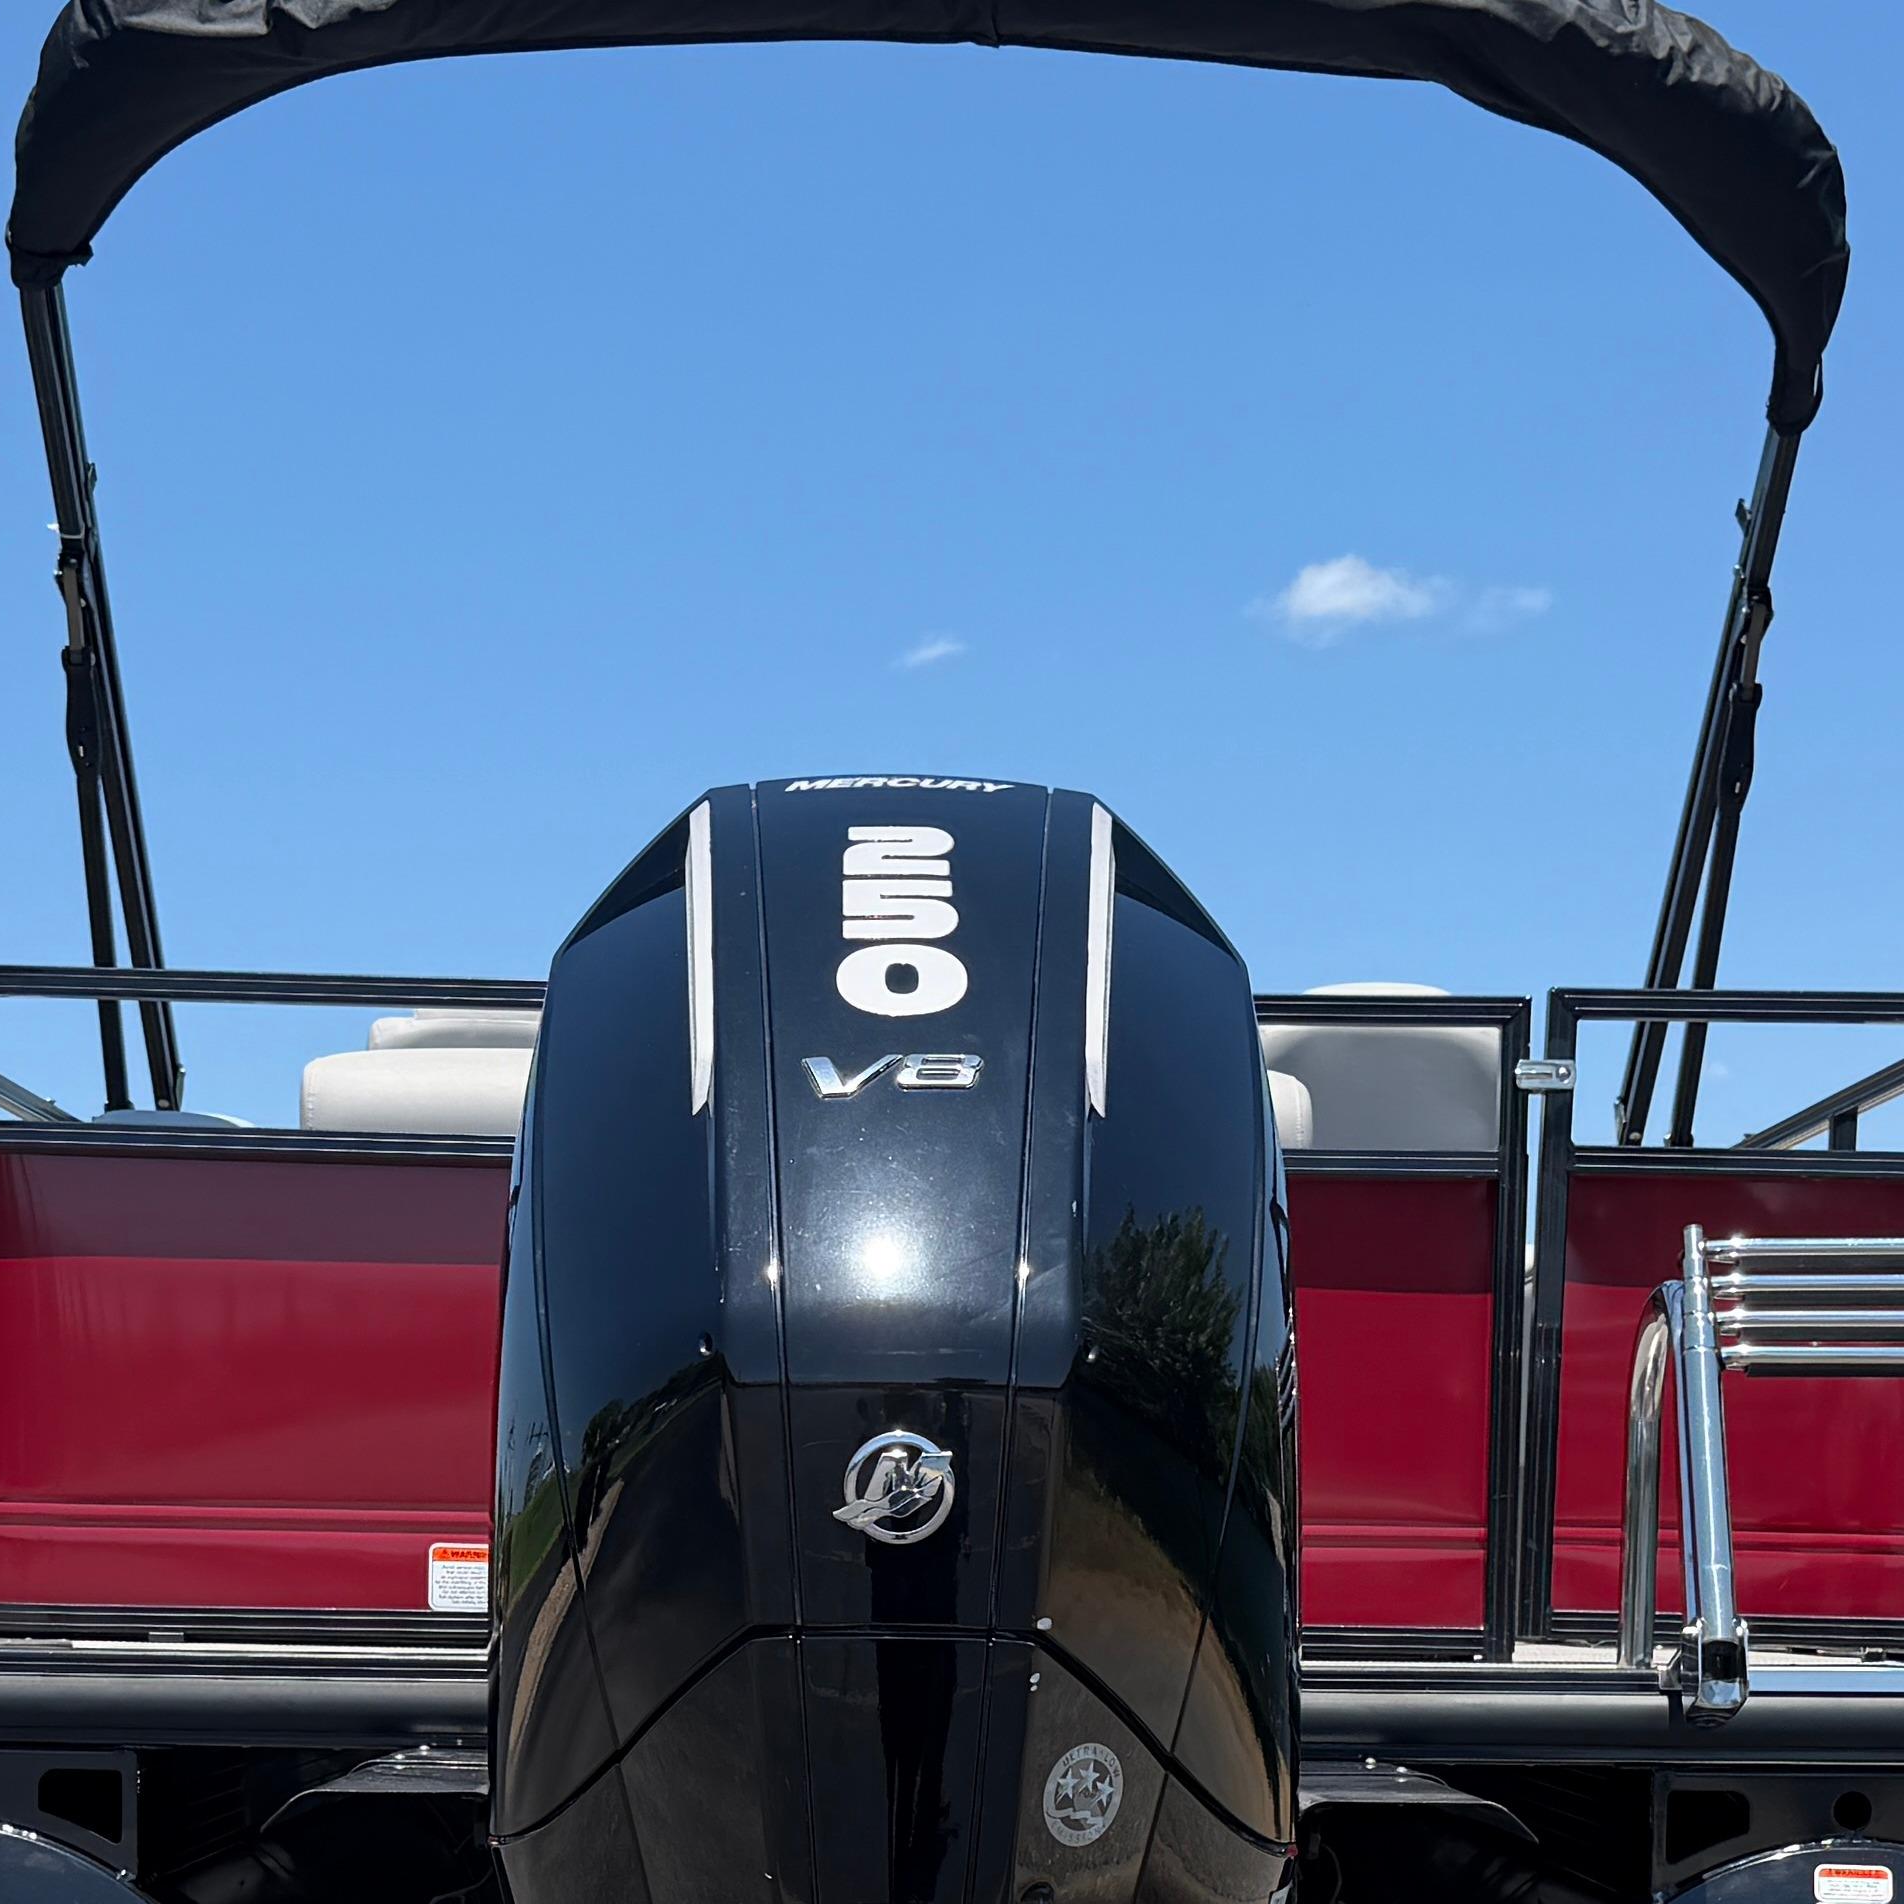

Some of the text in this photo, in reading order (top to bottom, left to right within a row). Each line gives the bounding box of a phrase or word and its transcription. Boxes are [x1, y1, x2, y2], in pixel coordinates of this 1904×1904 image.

[784, 777, 1016, 793] MERCURY
[835, 825, 969, 1017] 250
[801, 1053, 985, 1101] V8
